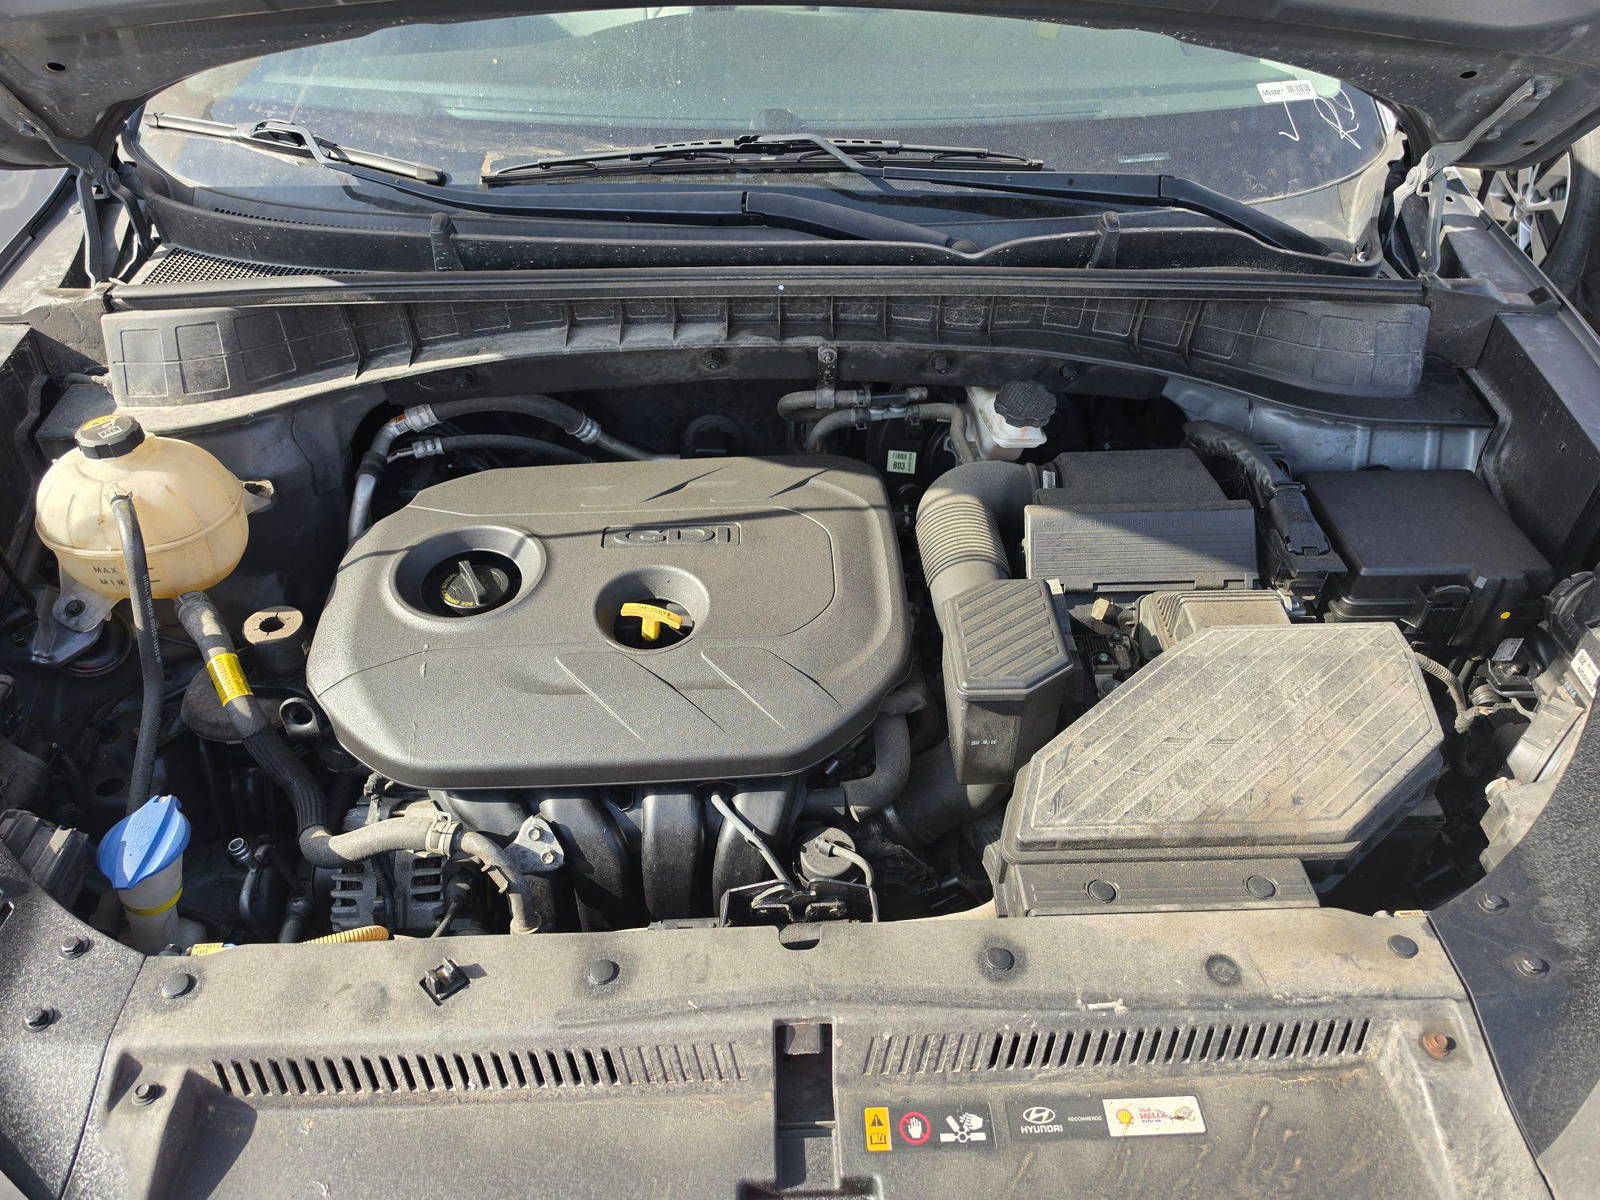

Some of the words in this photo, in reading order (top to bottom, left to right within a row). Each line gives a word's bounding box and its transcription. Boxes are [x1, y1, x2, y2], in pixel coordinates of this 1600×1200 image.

[613, 527, 732, 545] GDI
[92, 566, 119, 575] MAX
[98, 578, 125, 586] MIN
[1067, 1115, 1103, 1123] RECOMMENDS
[1139, 1112, 1167, 1120] HELIX
[1020, 1124, 1063, 1135] HYUNDAI
